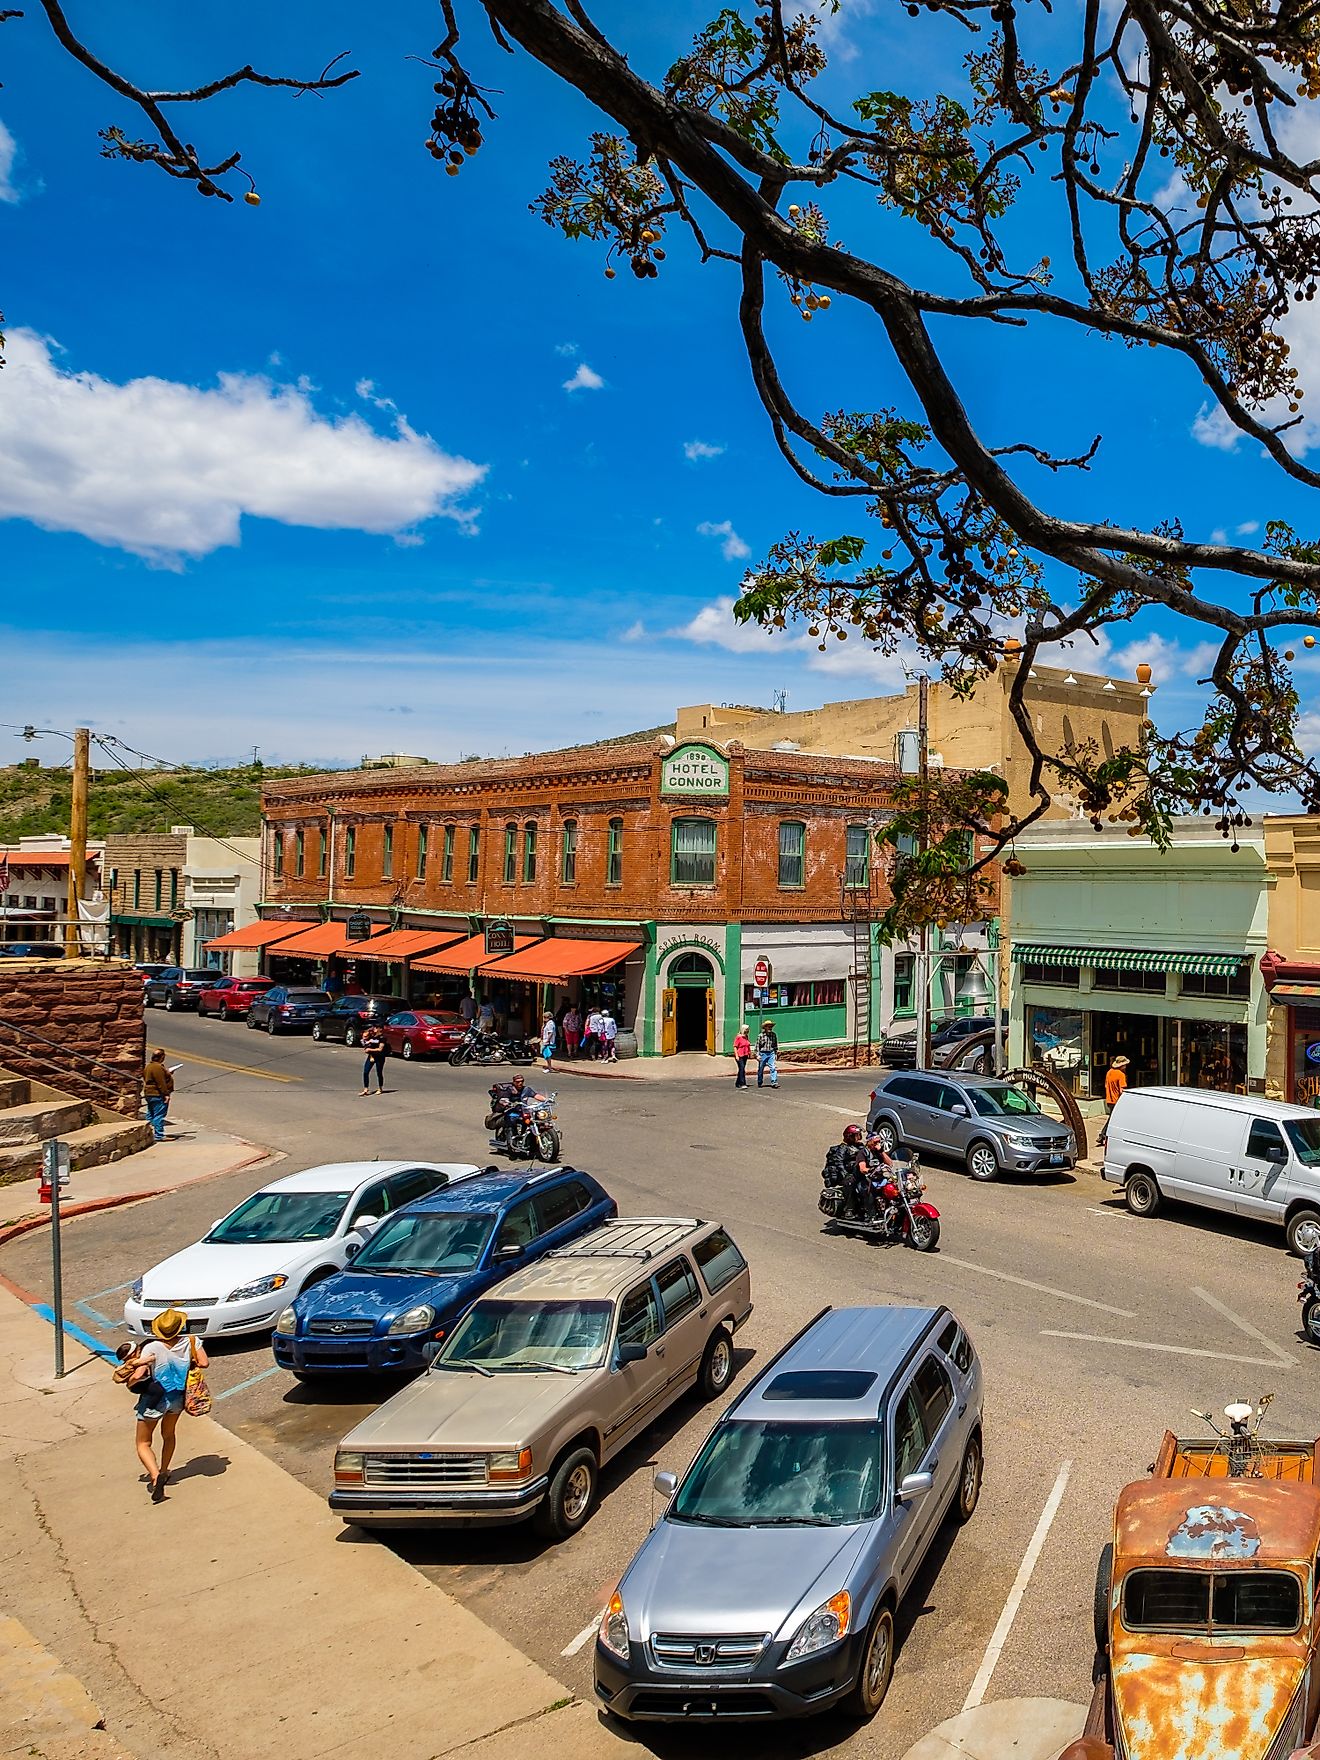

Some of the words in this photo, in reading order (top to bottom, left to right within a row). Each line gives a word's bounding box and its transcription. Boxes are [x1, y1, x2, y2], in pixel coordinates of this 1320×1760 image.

[672, 764, 718, 774] HOTEL
[669, 777, 721, 787] CONNOR
[659, 933, 687, 951] SPIRIT
[694, 933, 721, 952] ROOM
[1022, 1072, 1050, 1090] MUSEUM
